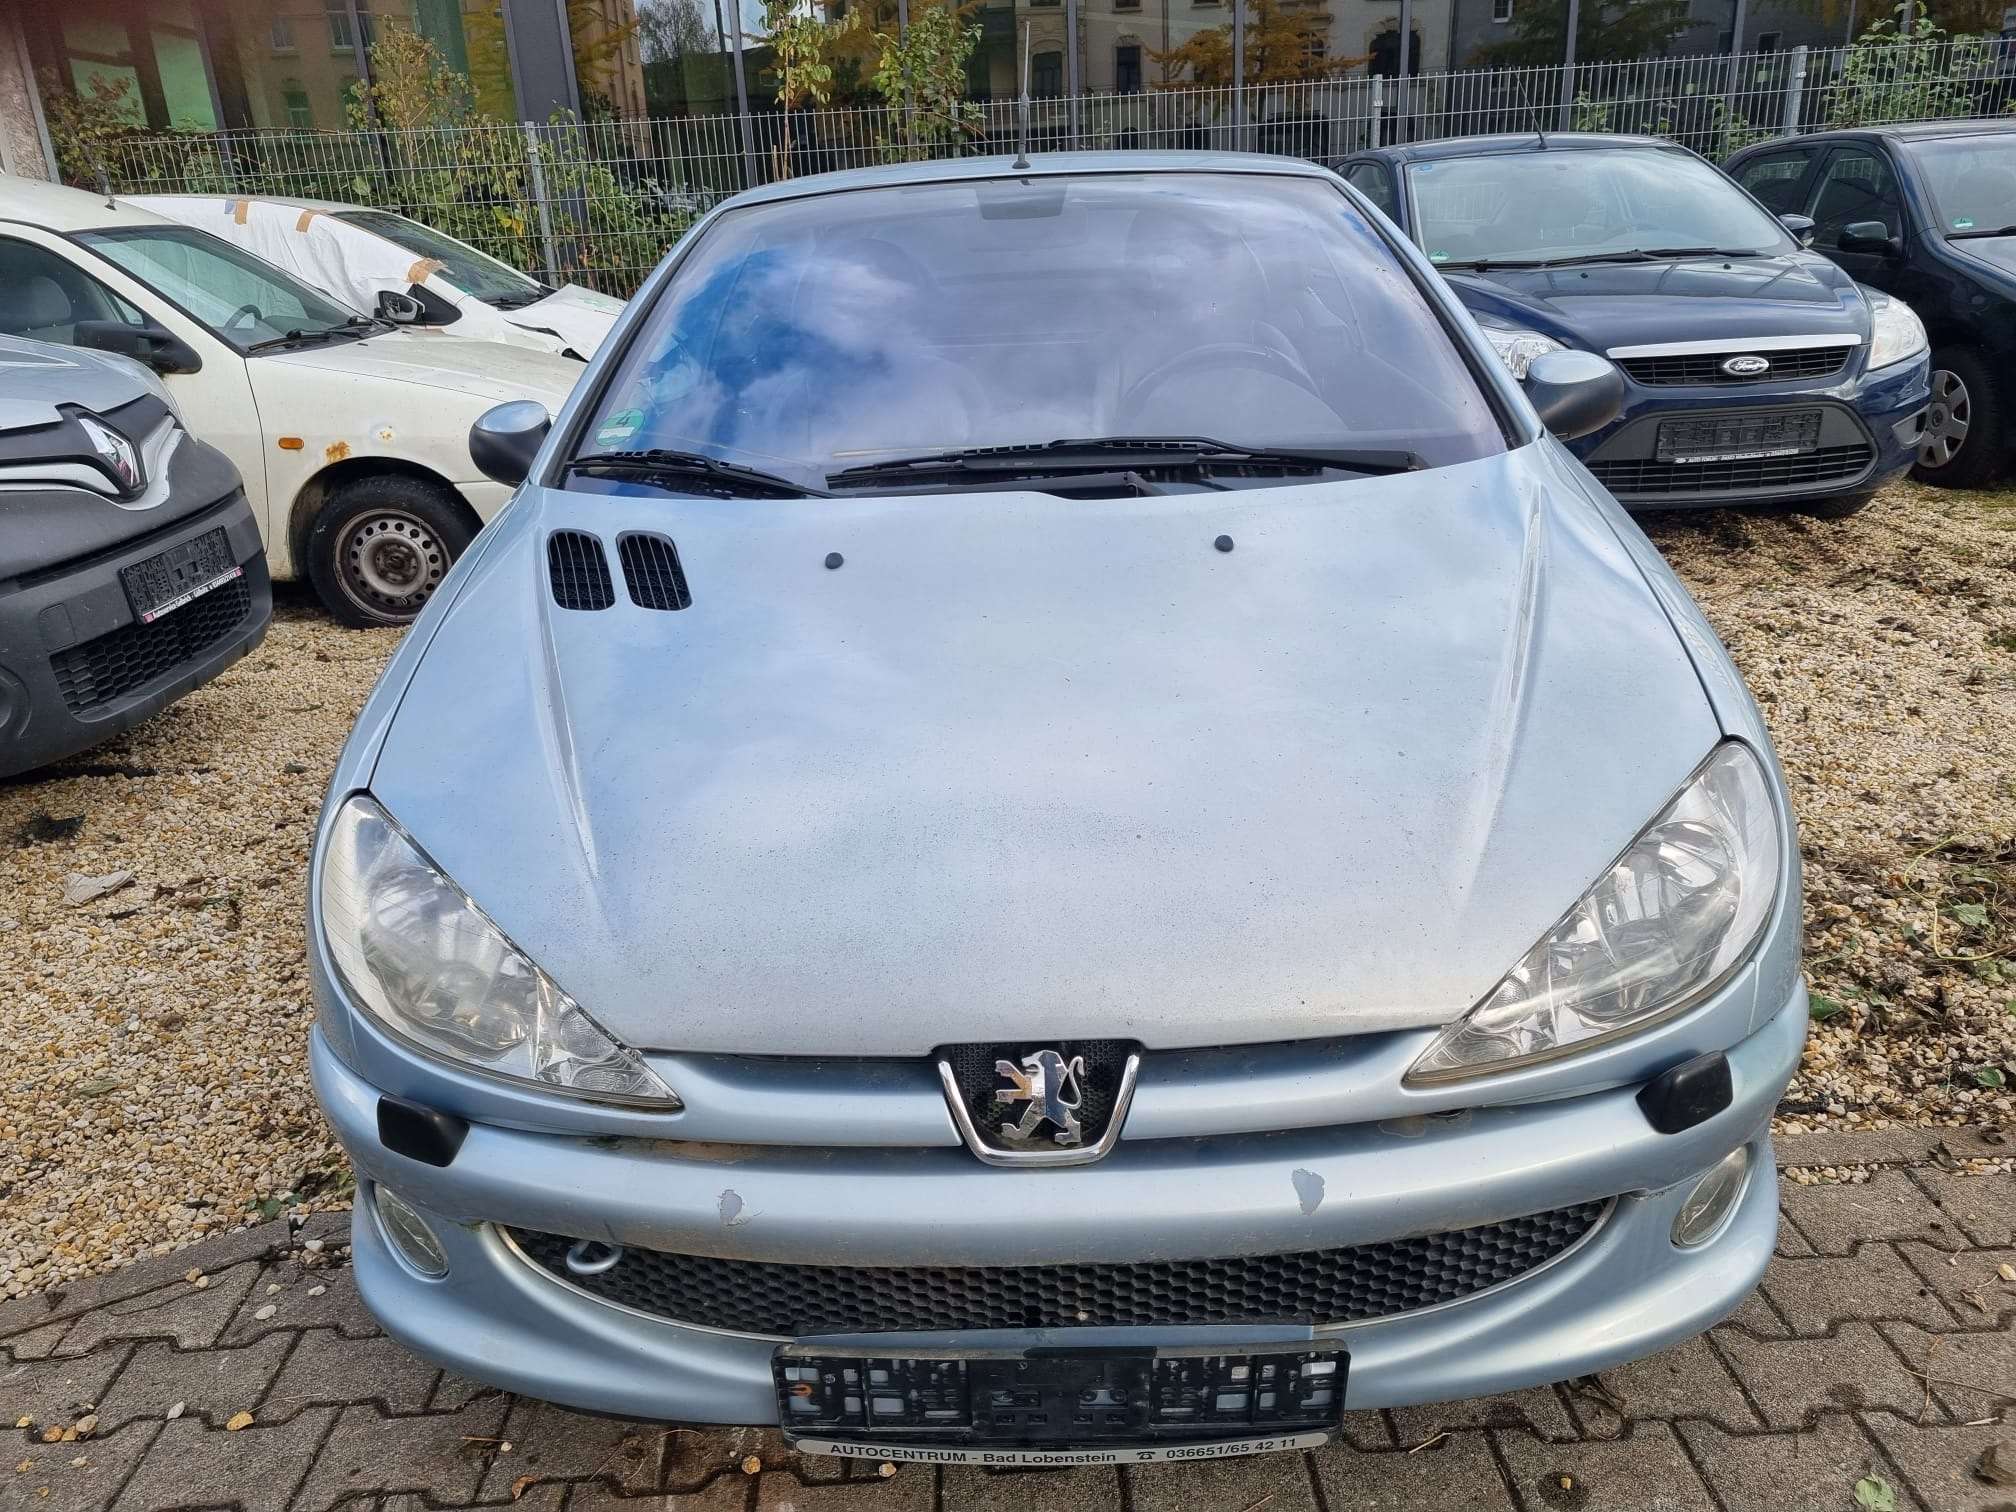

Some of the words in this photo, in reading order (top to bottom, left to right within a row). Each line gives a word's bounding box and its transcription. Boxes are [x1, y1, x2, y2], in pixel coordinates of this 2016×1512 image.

[615, 410, 632, 427] 4
[830, 1444, 967, 1462] AUTOCENTRUM
[983, 1452, 1016, 1463] Bad
[1022, 1452, 1116, 1463] Lobenstein
[1166, 1444, 1249, 1459] 036651/65
[1254, 1440, 1275, 1451] 42
[1280, 1438, 1296, 1448] 11
